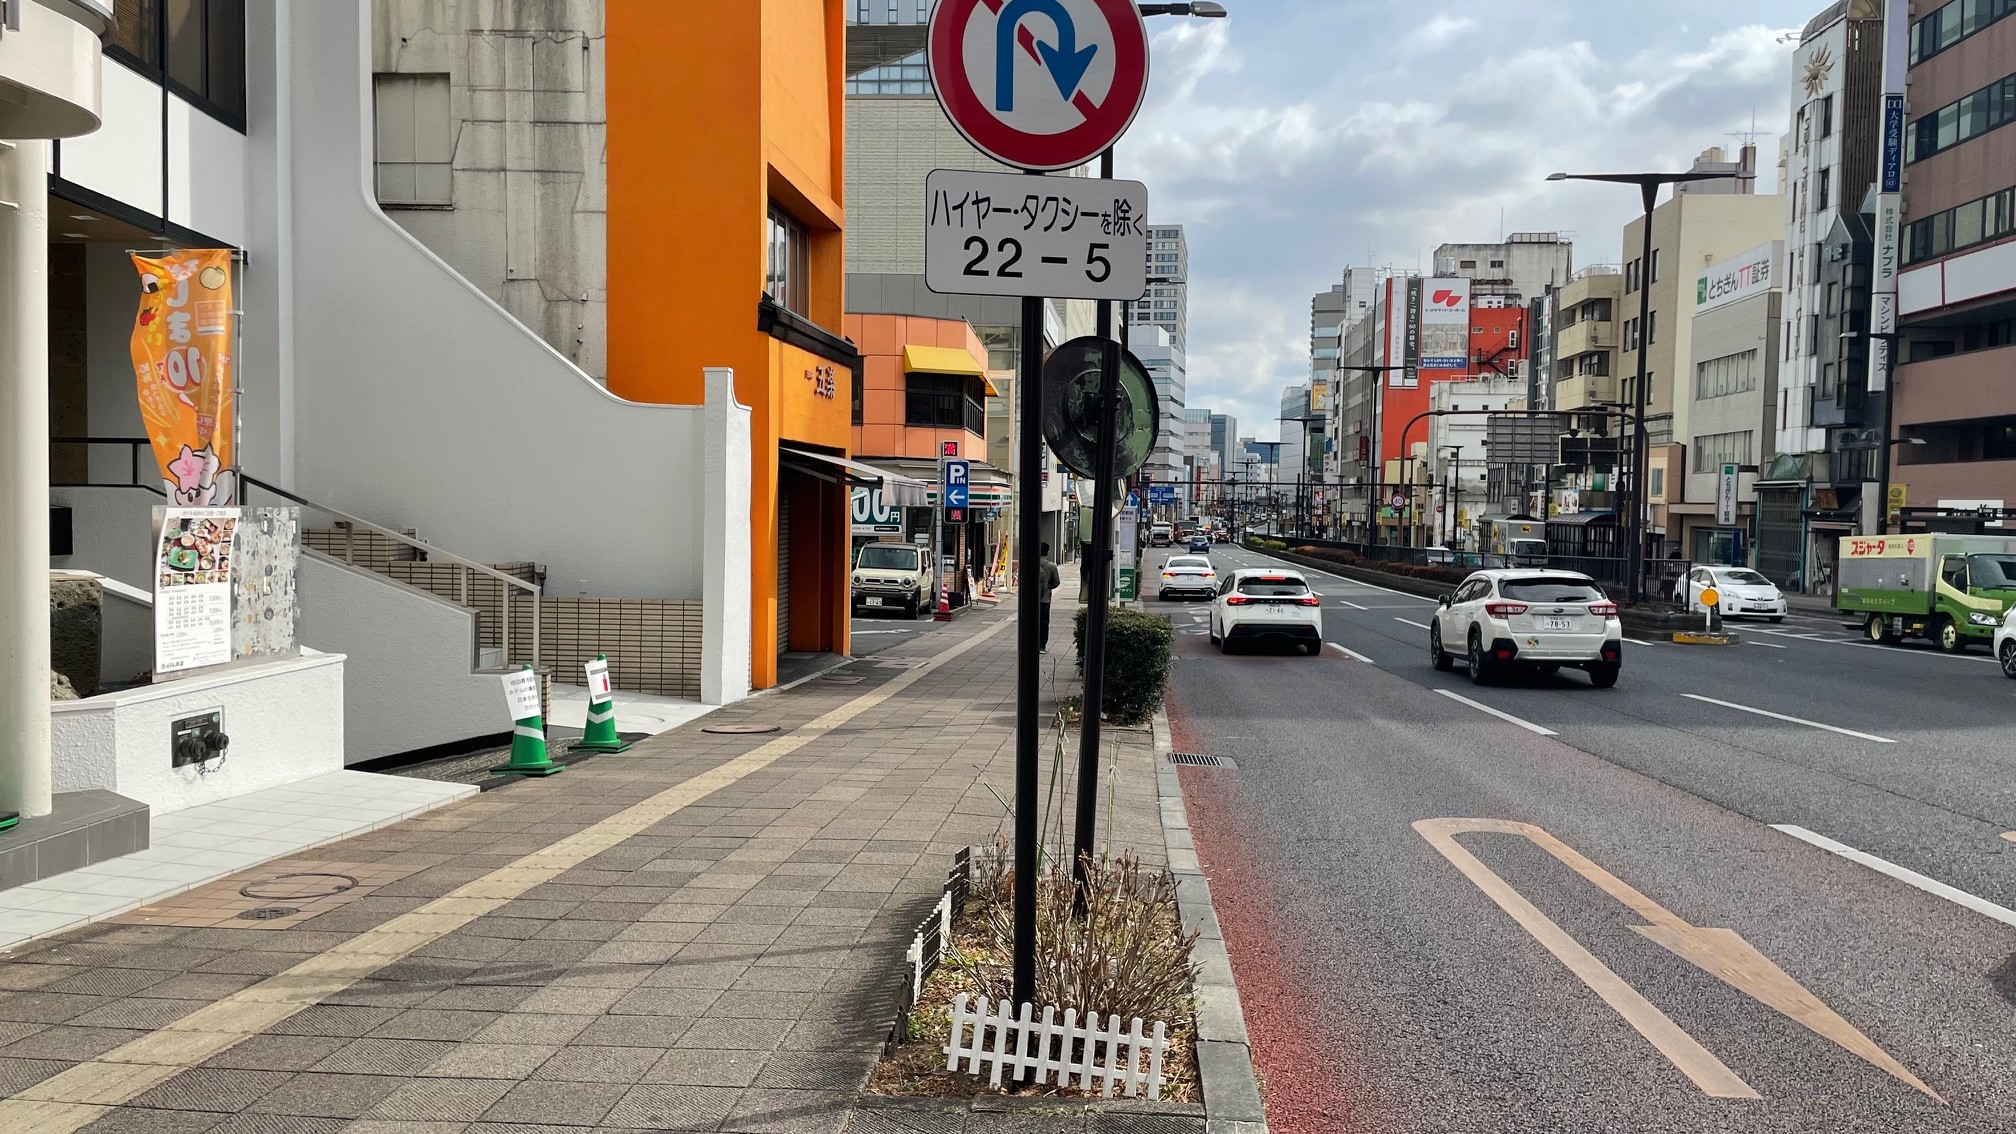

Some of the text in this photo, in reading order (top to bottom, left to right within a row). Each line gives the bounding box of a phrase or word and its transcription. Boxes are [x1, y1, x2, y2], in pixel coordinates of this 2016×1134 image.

[931, 189, 1144, 237] ハイヤー・タクシーを除く
[1885, 208, 1893, 241] 株式会社
[1708, 258, 1770, 300] とちぎんTT証券
[1851, 540, 1885, 556] スジャータ
[1550, 620, 1571, 628] 78-53
